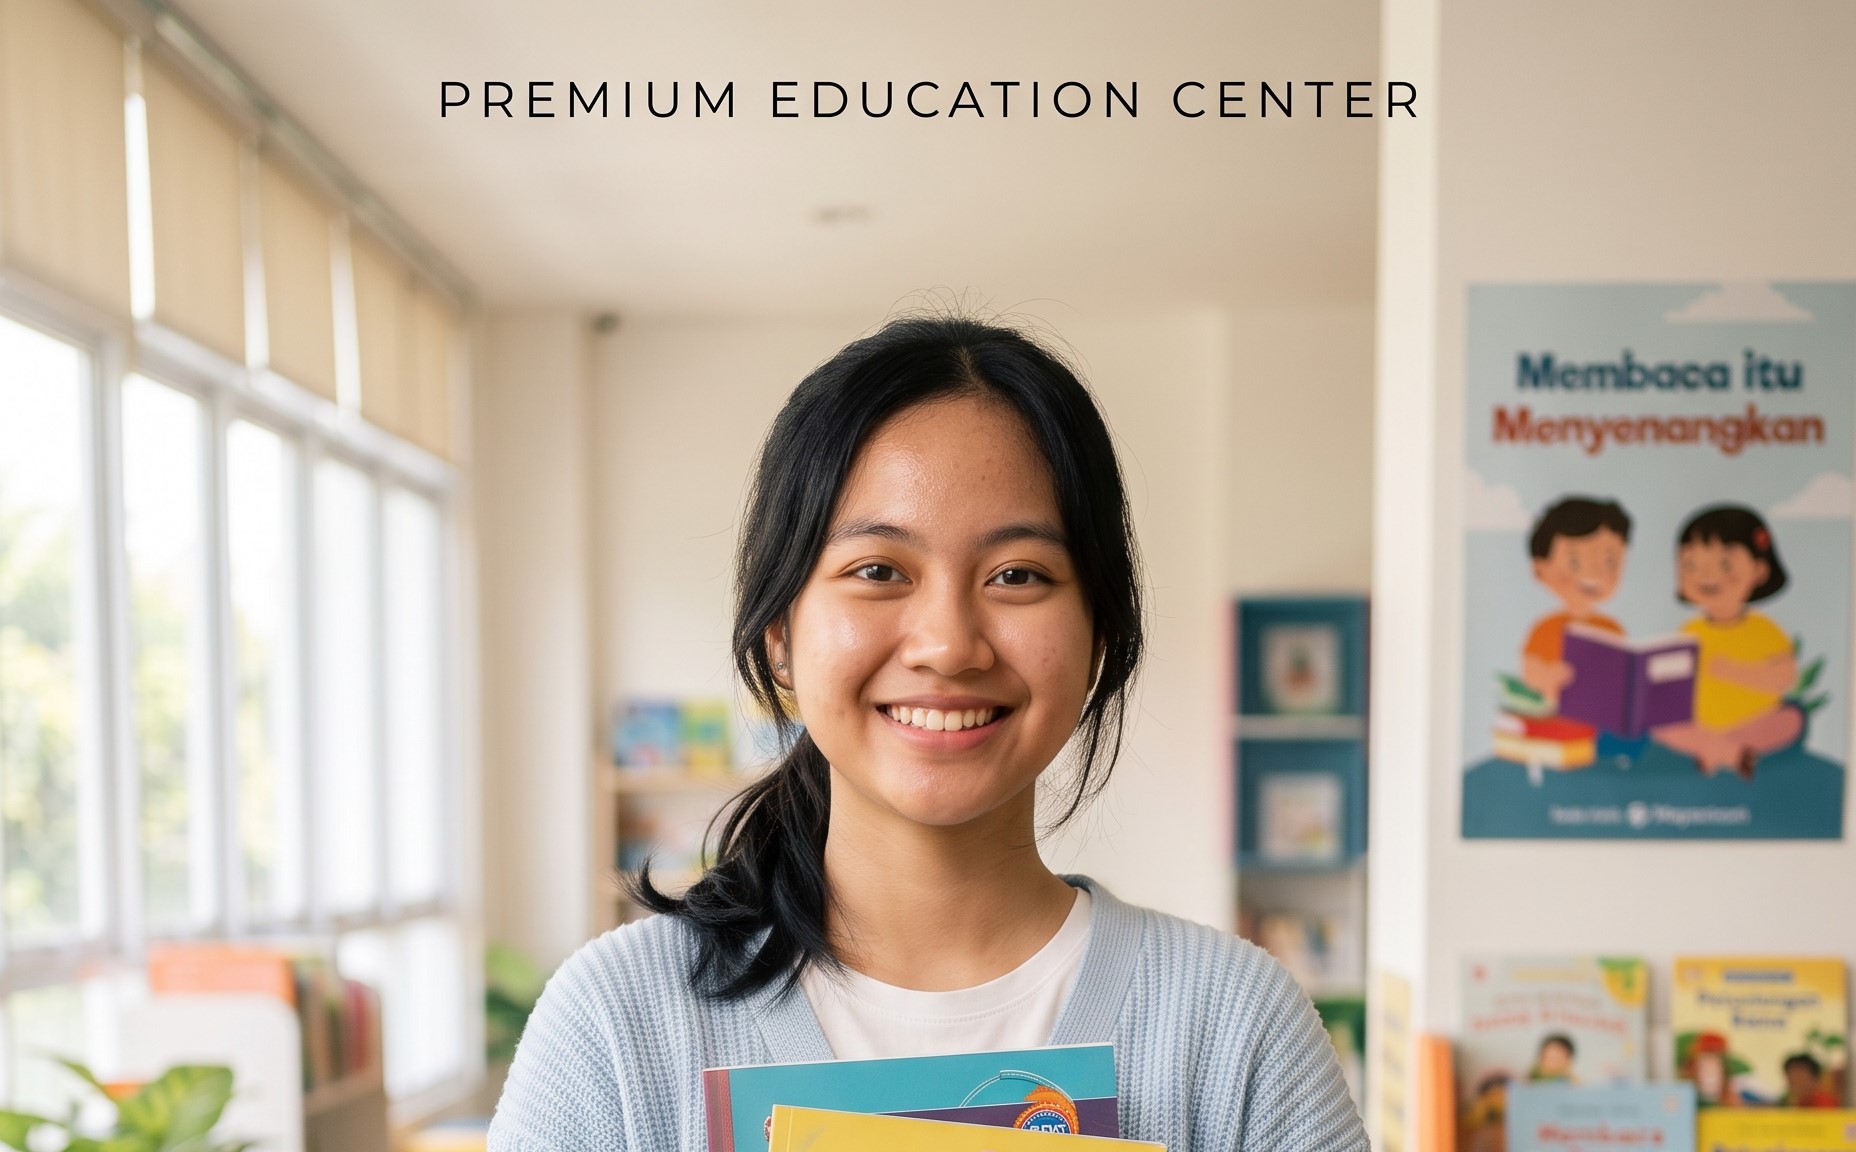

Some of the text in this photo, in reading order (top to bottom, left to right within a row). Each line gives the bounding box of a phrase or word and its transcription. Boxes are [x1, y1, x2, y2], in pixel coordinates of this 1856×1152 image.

[1517, 349, 1803, 391] Membaca itu
[1493, 404, 1825, 456] Menyenangkan
